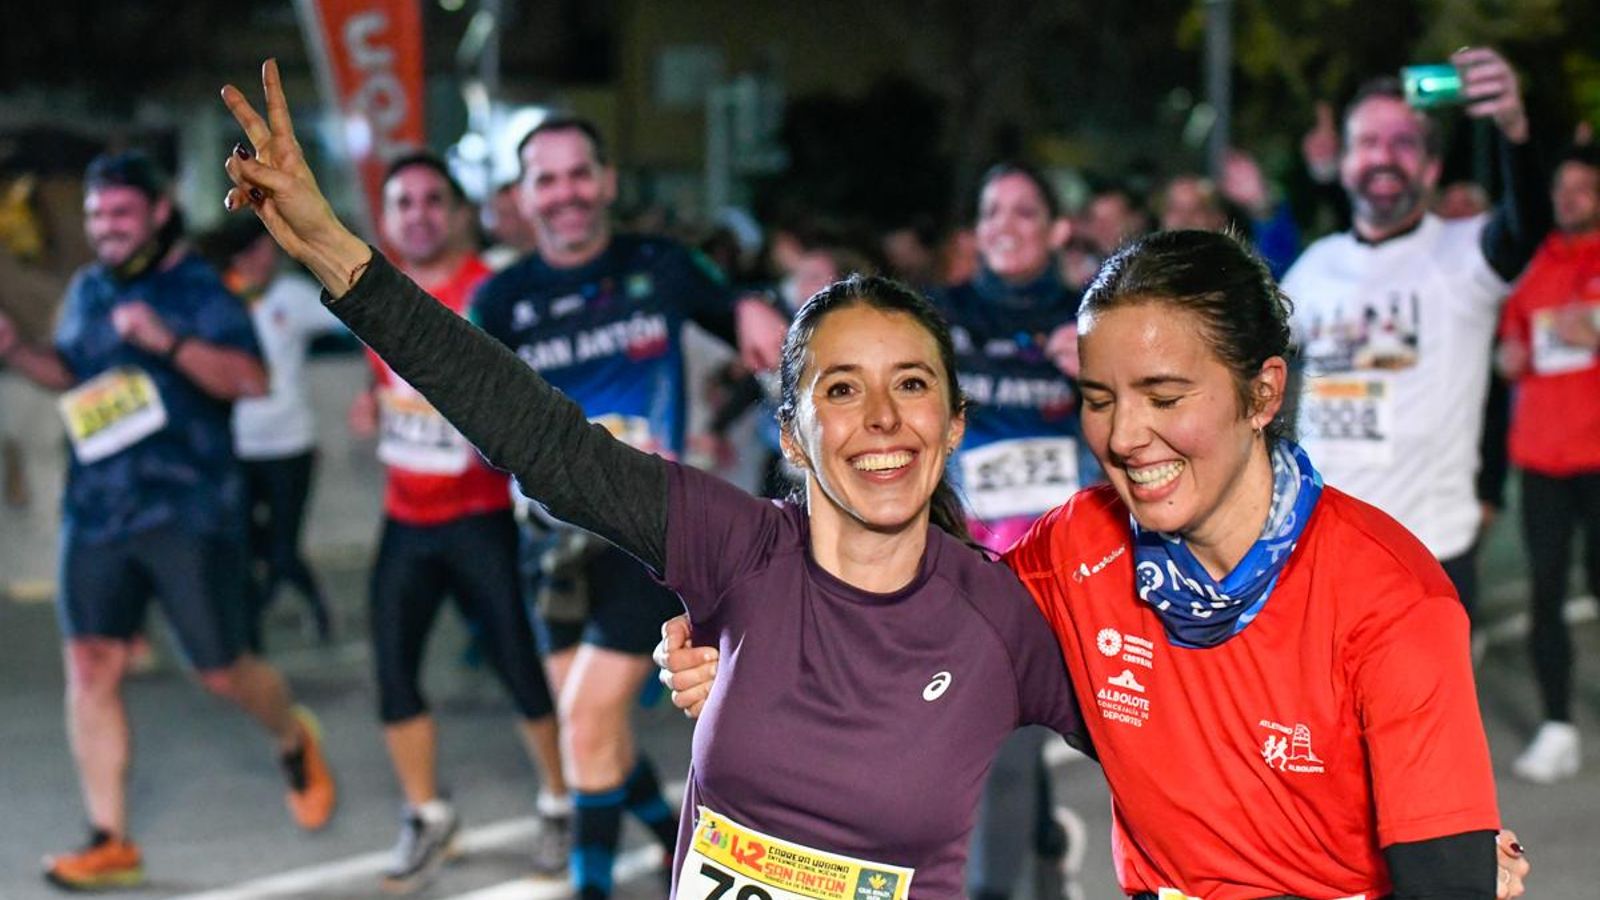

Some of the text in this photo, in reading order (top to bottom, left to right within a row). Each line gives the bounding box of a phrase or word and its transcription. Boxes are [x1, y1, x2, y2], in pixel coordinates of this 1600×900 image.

[1097, 687, 1150, 711] ALBOLOTE
[1103, 709, 1143, 728] DEPORTES
[730, 834, 767, 873] 42
[768, 846, 850, 874] CARRERA URBANA
[764, 862, 794, 881] SAN
